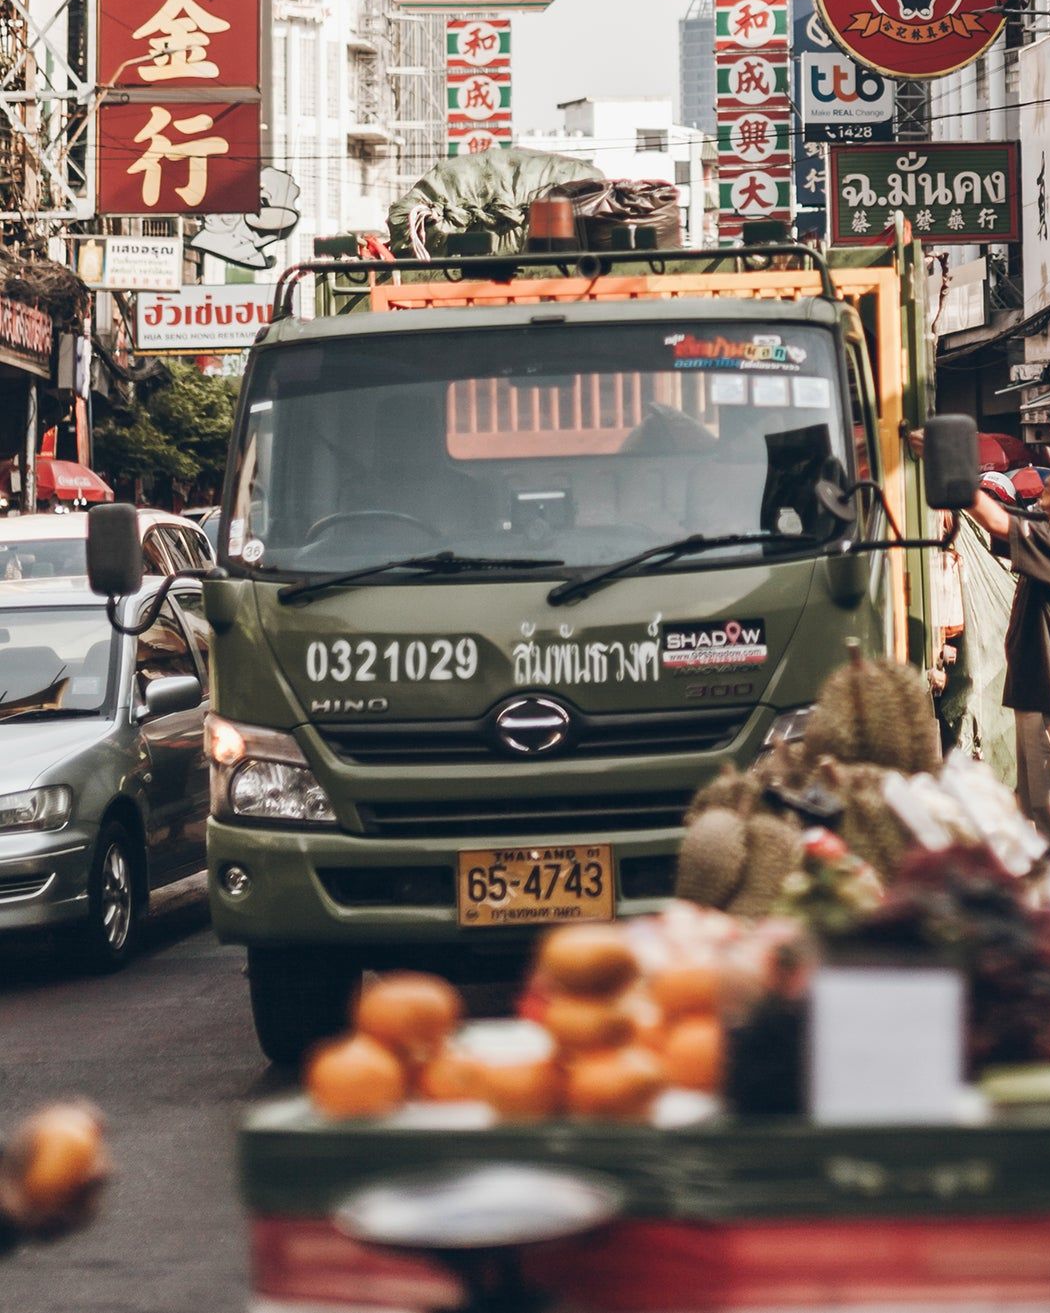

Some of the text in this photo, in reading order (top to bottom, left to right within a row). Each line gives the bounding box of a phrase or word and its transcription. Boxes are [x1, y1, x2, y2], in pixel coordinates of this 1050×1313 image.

[811, 64, 885, 103] ttb
[811, 109, 885, 119] Make REAL Change
[839, 125, 873, 139] 1428
[842, 151, 1006, 207] ฉ.มั่นคง
[246, 546, 261, 557] 36
[512, 612, 662, 684] สัมพันธวงศ์
[666, 621, 761, 649] SHADOW
[306, 637, 478, 682] 0321029
[310, 697, 388, 713] HINO
[468, 861, 604, 903] 65-4743
